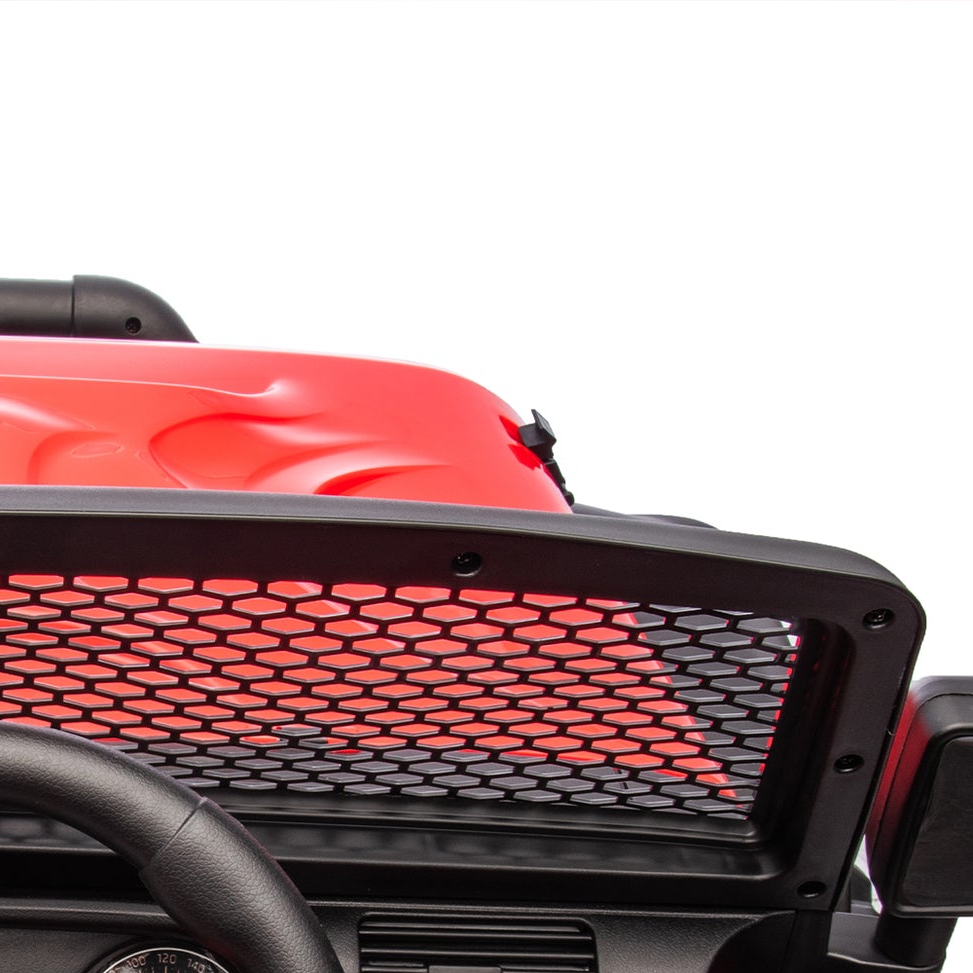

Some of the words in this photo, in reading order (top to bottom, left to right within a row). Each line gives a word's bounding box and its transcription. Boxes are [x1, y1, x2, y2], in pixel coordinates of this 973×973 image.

[127, 956, 146, 968] 100
[157, 954, 176, 964] 120
[187, 958, 205, 973] 140
